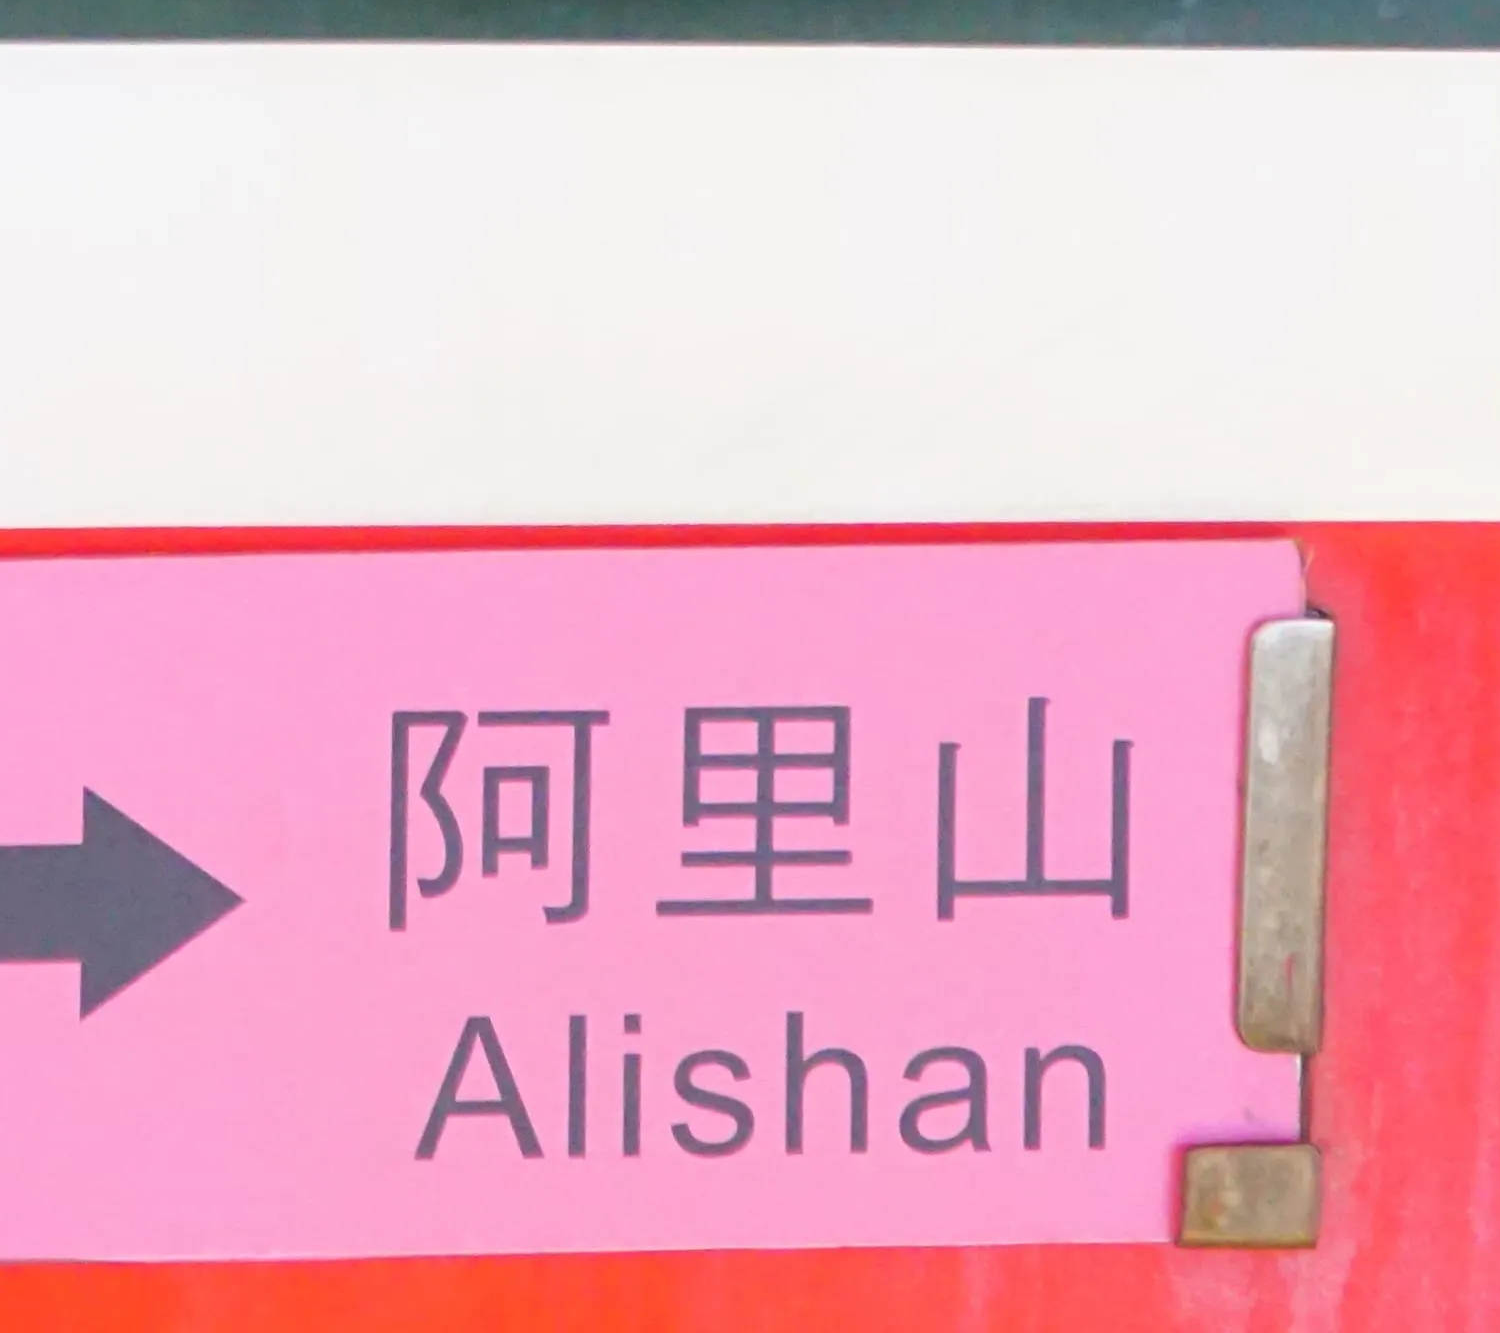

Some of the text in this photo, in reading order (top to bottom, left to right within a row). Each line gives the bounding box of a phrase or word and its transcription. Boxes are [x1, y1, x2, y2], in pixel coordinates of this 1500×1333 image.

[388, 696, 1132, 930] 阿里山
[415, 1010, 1106, 1159] Alishan
